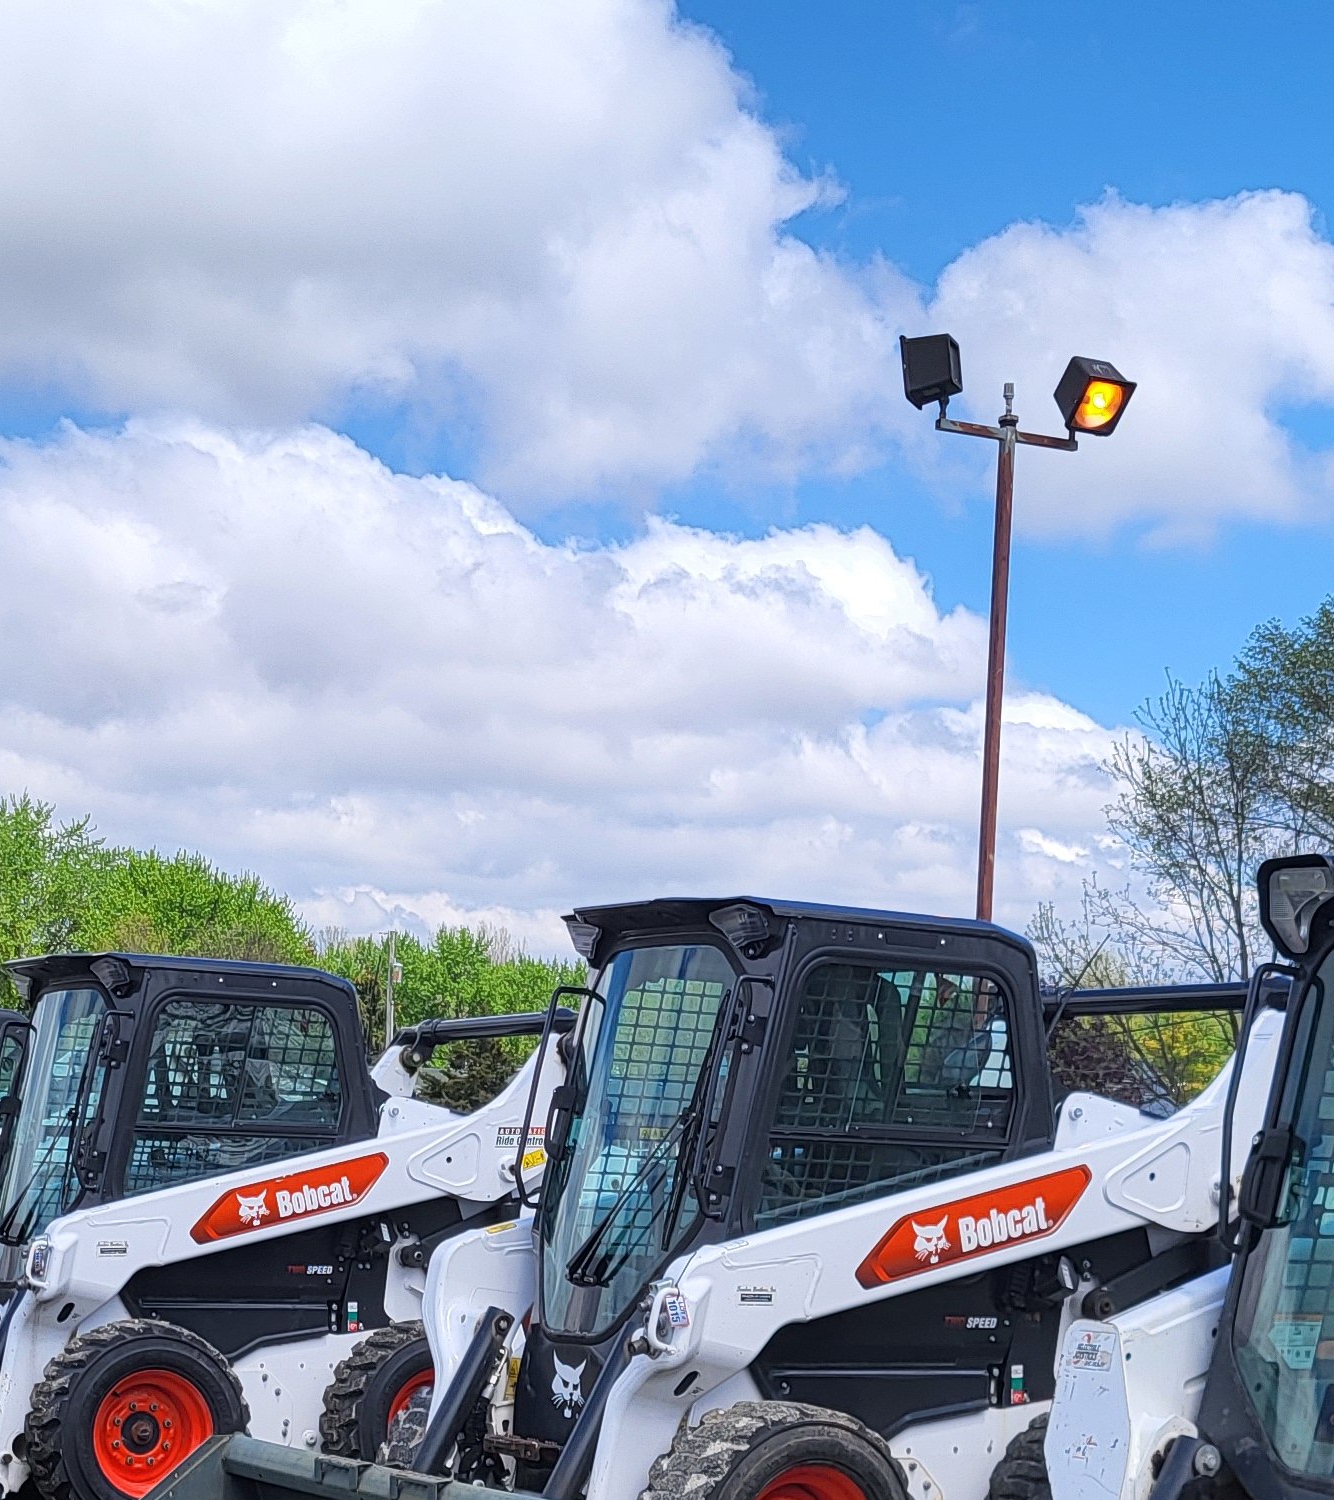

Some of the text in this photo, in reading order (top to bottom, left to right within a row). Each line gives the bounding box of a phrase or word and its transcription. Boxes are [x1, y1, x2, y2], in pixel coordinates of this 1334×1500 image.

[495, 1136, 515, 1146] Ride
[275, 1175, 353, 1218] Bobcat
[957, 1196, 1048, 1253] Bobcat
[306, 1265, 334, 1275] SPEED
[667, 1299, 681, 1323] 1015
[966, 1316, 998, 1329] SPEED
